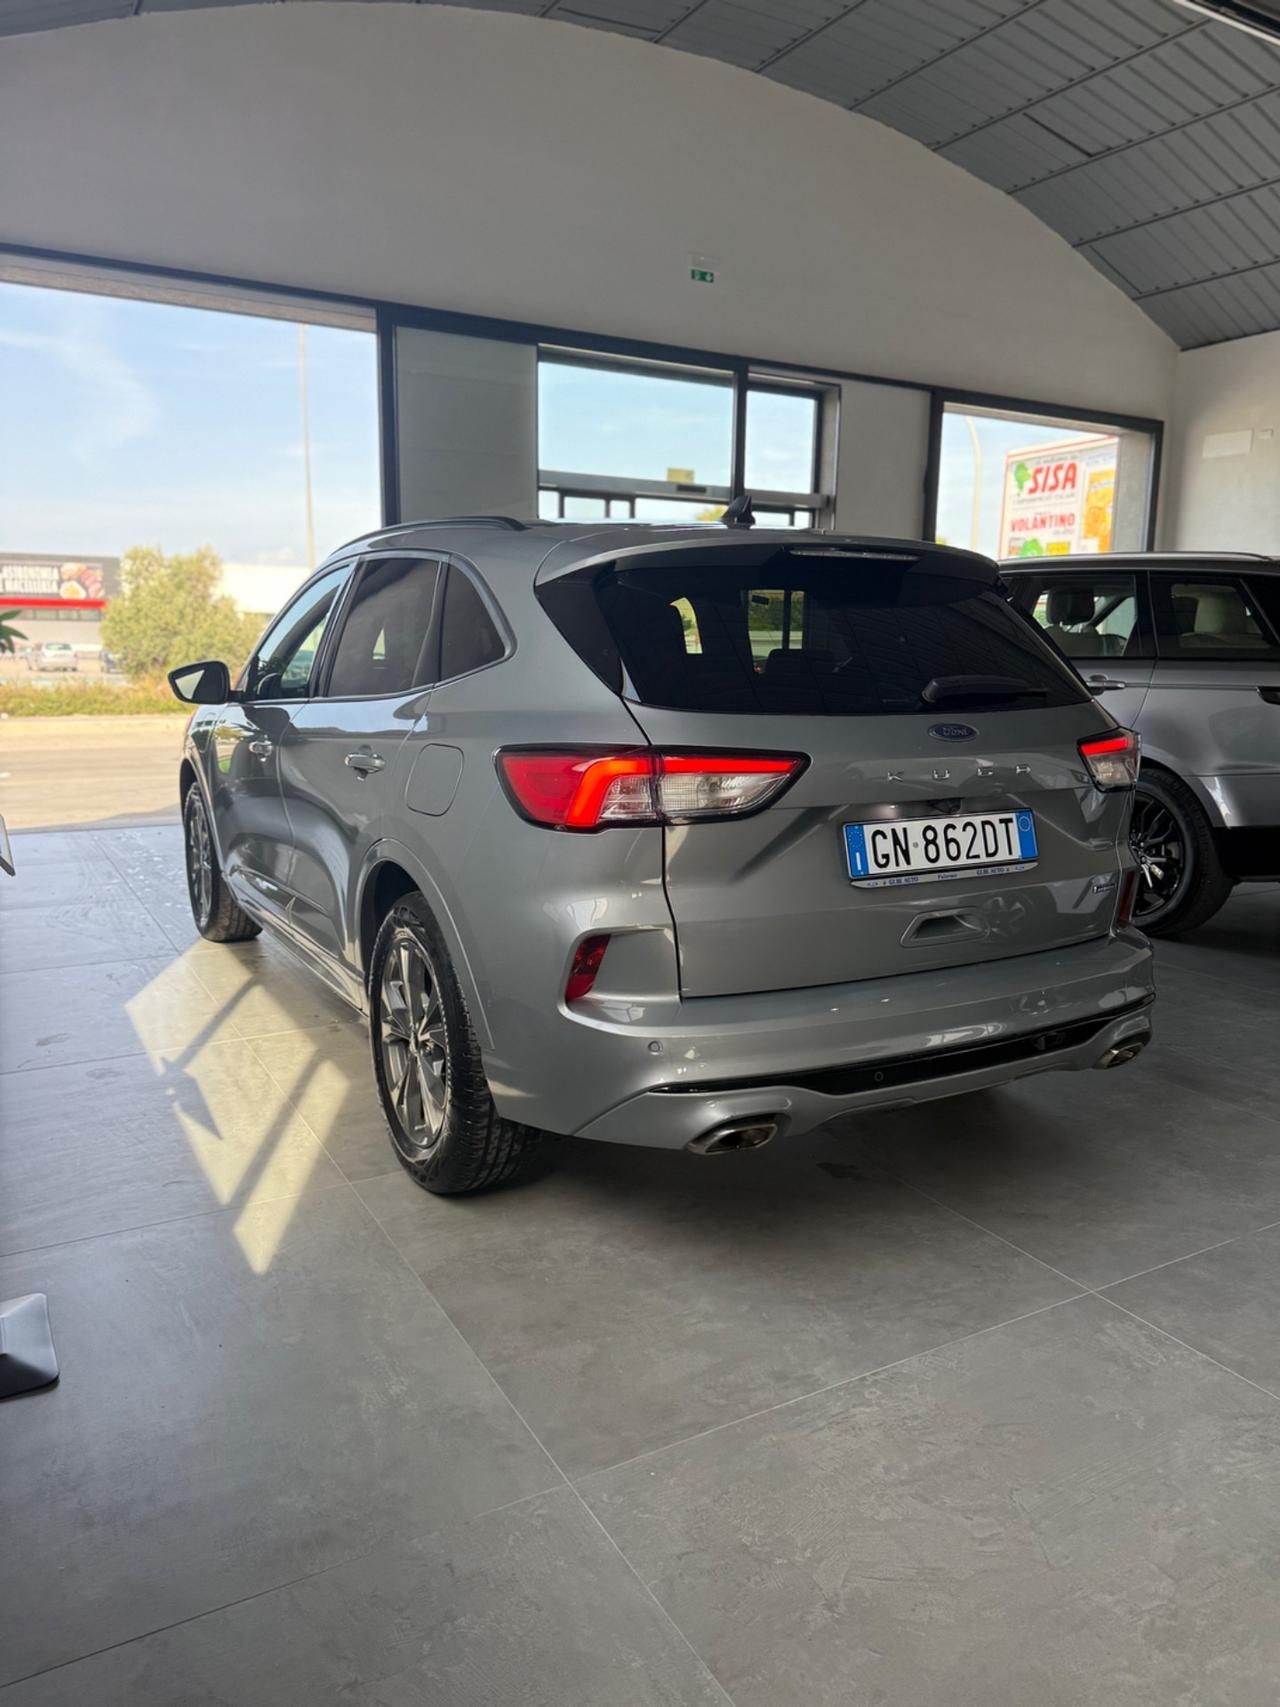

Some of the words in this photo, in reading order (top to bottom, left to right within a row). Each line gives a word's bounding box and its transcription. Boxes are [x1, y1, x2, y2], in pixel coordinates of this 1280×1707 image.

[1028, 462, 1077, 495] SISA
[1010, 512, 1075, 532] VOLANTINO
[870, 827, 911, 869] GN
[921, 817, 1014, 864] 862DT
